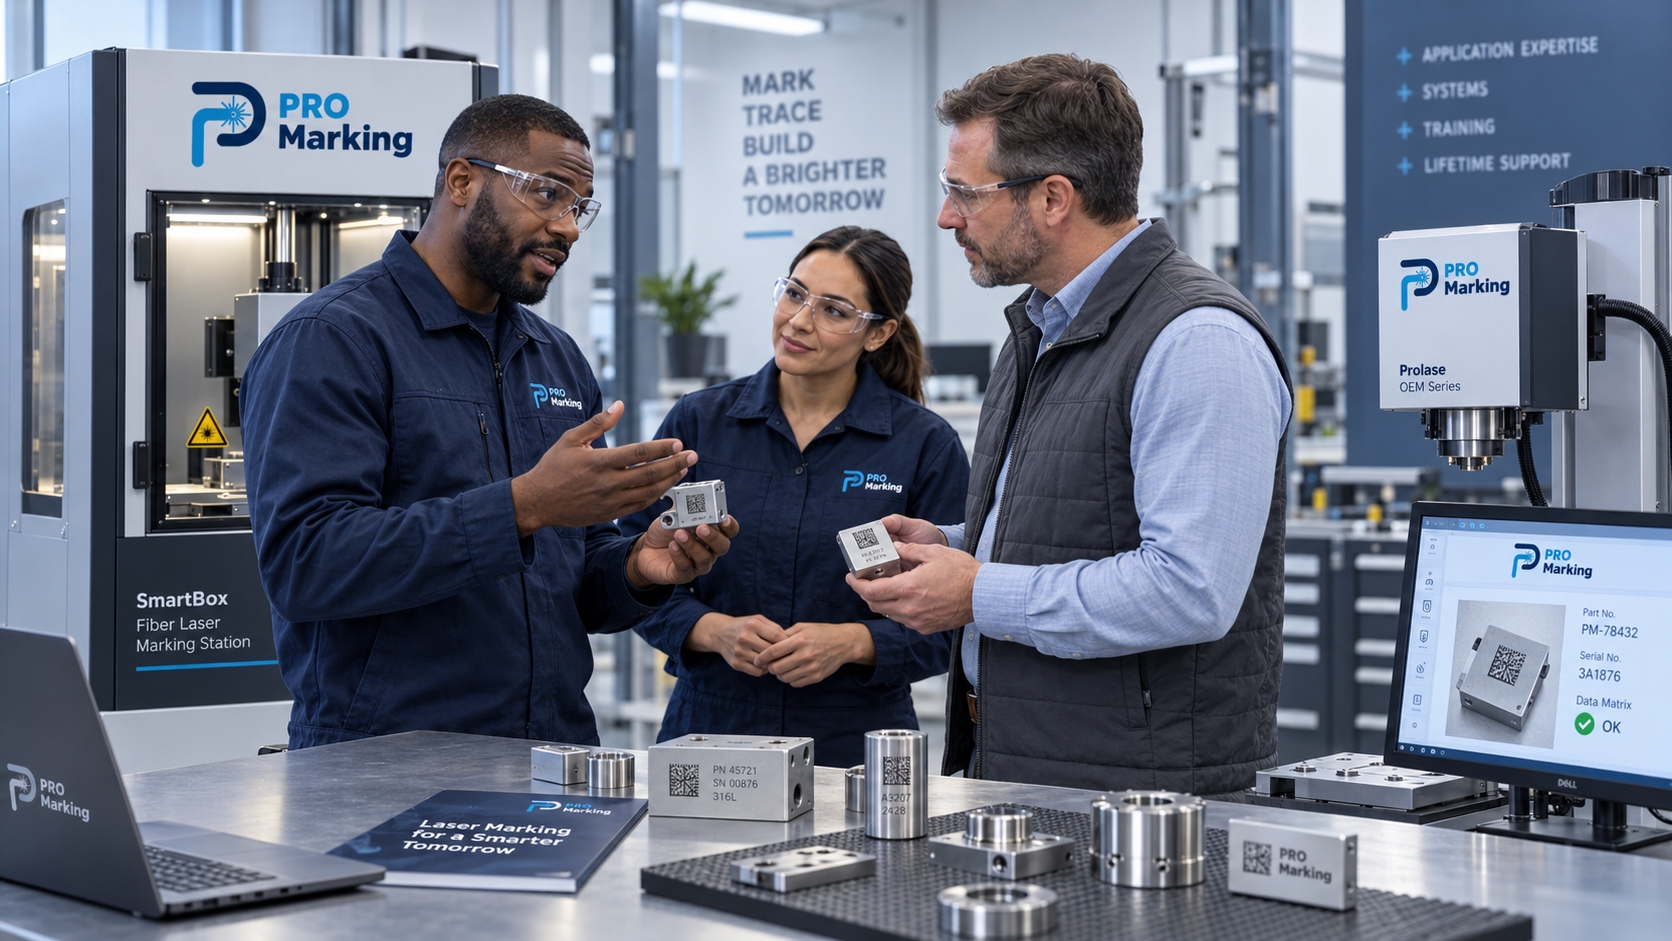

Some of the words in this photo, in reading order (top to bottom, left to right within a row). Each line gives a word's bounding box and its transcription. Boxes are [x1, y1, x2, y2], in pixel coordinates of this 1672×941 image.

[1422, 41, 1514, 63] APPLICATION
[1520, 36, 1599, 57] EXPERTISE
[742, 68, 815, 97] MARK
[1422, 80, 1489, 100] SYSTEMS
[279, 92, 350, 119] PRO
[742, 100, 822, 127] TRACE
[1423, 118, 1496, 138] TRAINING
[278, 123, 413, 158] Marking
[743, 132, 814, 157] BUILD
[1424, 155, 1495, 174] LIFETIME
[1499, 152, 1571, 171] SUPPORT
[742, 165, 759, 187] A
[765, 157, 887, 186] BRIGHTER
[743, 188, 886, 216] TOMORROW
[1444, 261, 1479, 278] PRO
[1444, 278, 1510, 296] Marking
[1400, 363, 1446, 376] Prolase
[549, 387, 566, 397] PRO
[1399, 381, 1425, 392] OEM
[1428, 380, 1461, 392] Series
[551, 397, 583, 410] Marking
[867, 473, 887, 482] PRO
[865, 482, 903, 493] Marking
[1545, 549, 1571, 561] PRO
[1543, 562, 1593, 579] Marking
[136, 591, 229, 609] SmartBox
[1583, 607, 1600, 618] Part
[1601, 609, 1616, 619] No.
[137, 618, 175, 632] Fiber
[180, 617, 221, 630] Laser
[1581, 623, 1639, 639] PM-78432
[136, 638, 195, 654] Marking
[200, 636, 251, 651] Station
[1579, 650, 1604, 662] Serial
[1606, 653, 1621, 663] No.
[1578, 667, 1621, 683] 3A1876
[1576, 695, 1599, 707] Data
[1601, 697, 1632, 710] Matrix
[1602, 719, 1621, 734] OK
[712, 765, 726, 774] PN
[728, 765, 757, 775] 45721
[40, 778, 65, 796] PRO
[712, 778, 726, 788] SN
[728, 779, 759, 789] 00876
[1557, 778, 1577, 789] DELL
[712, 792, 737, 802] 316L
[881, 793, 911, 803] A3207
[40, 794, 90, 823] Marking
[563, 807, 612, 816] Marking
[882, 806, 907, 815] 2428
[419, 819, 480, 832] Laser
[484, 822, 572, 837] Marking
[411, 829, 446, 841] for
[450, 833, 464, 842] a
[470, 833, 564, 847] Smarter
[403, 841, 515, 855] Tomorrow
[1279, 847, 1307, 862] PRO
[1279, 863, 1332, 884] Marking
